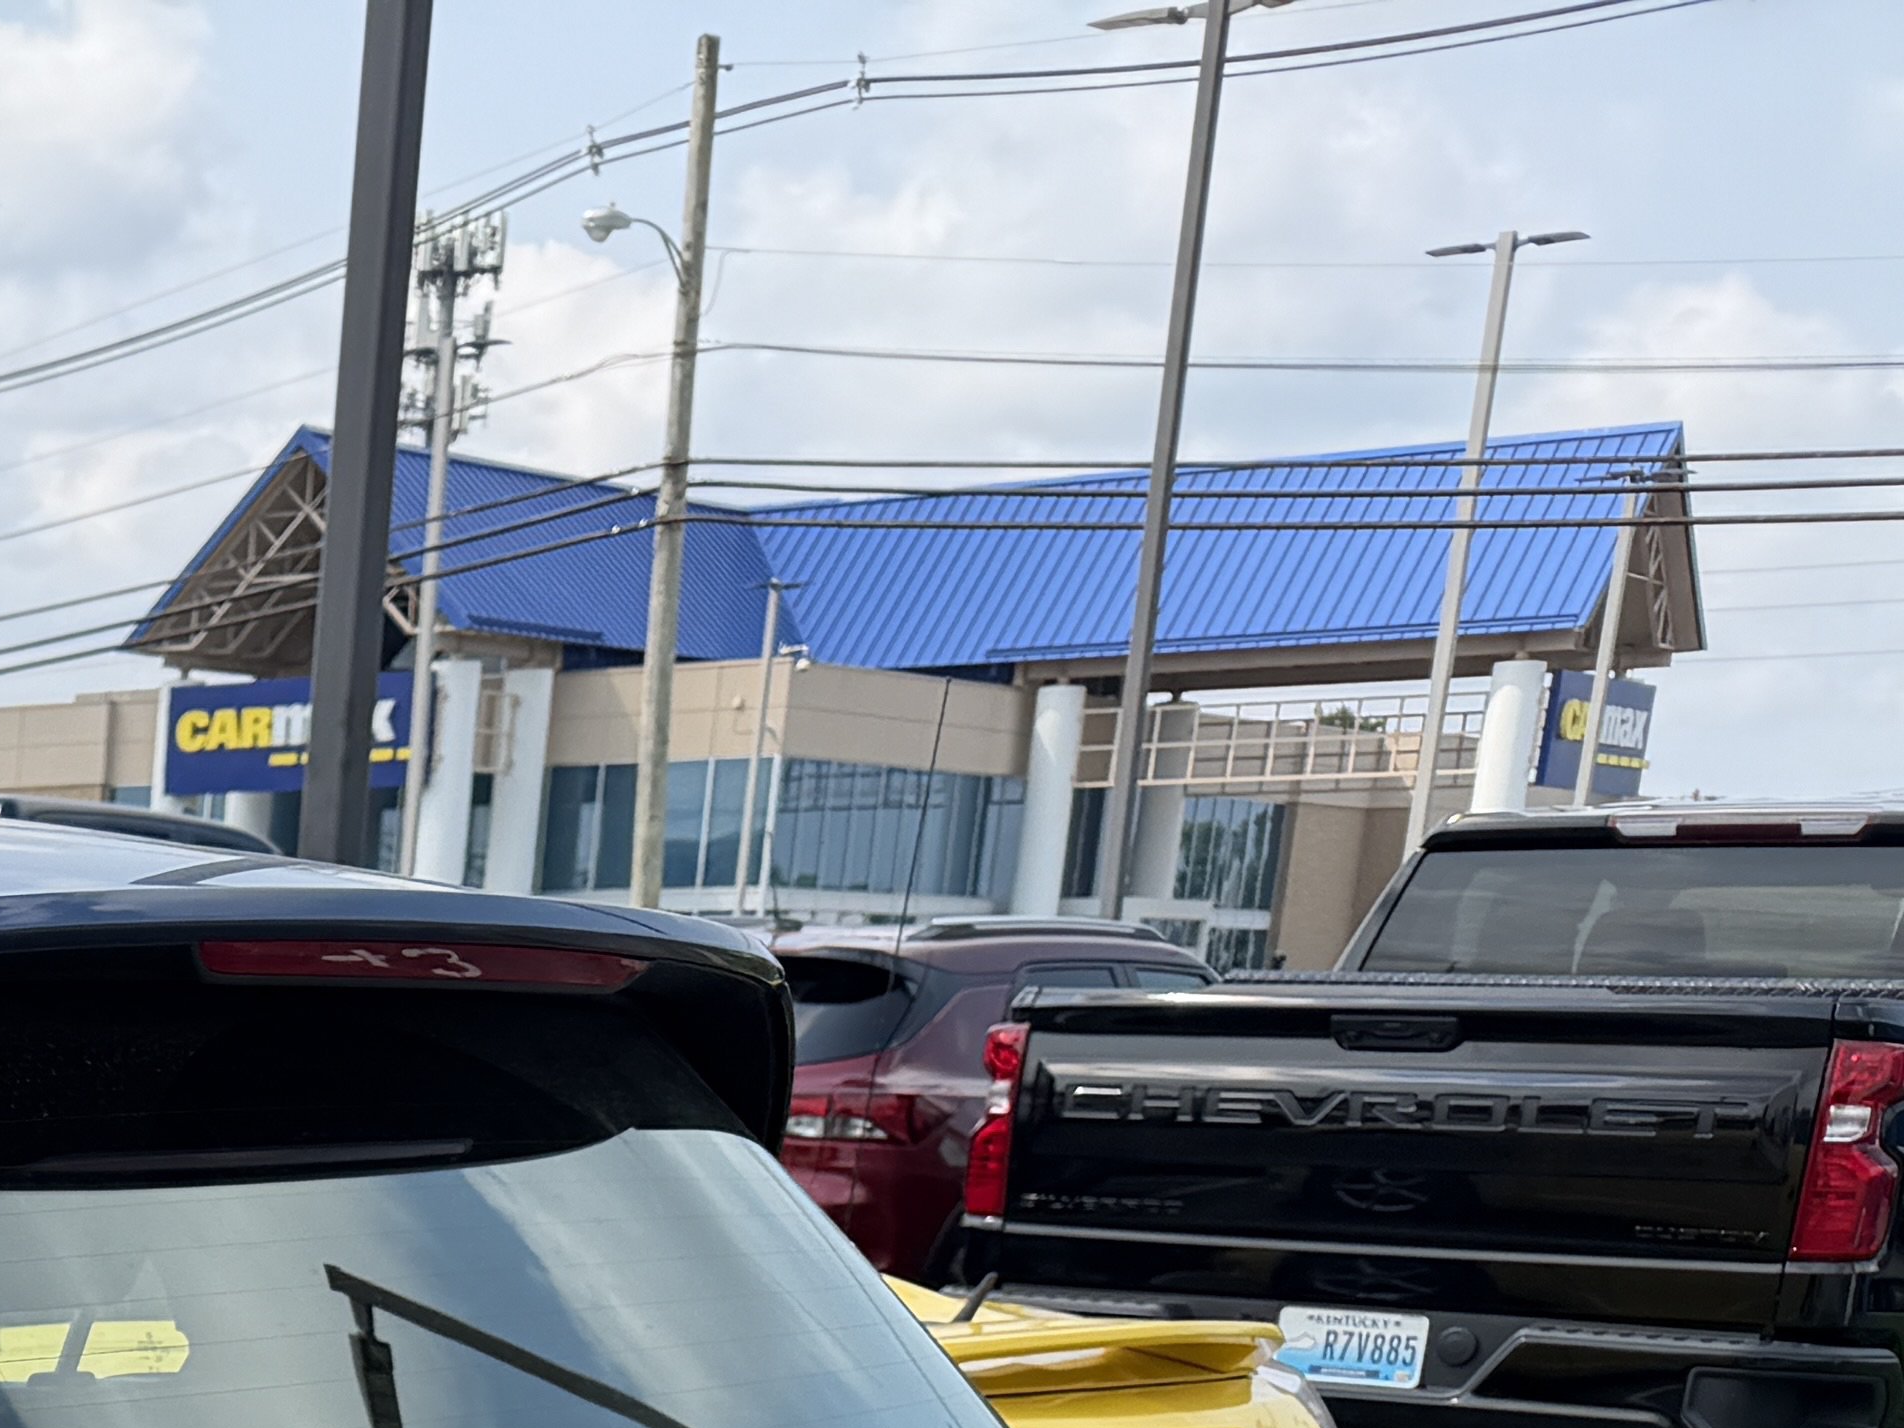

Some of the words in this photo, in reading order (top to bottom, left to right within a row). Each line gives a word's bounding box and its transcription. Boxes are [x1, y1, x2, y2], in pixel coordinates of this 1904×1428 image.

[1061, 1083, 1752, 1139] CHEVROLET
[1315, 1313, 1391, 1329] KENTUCKY
[1322, 1329, 1419, 1367] R7V885
